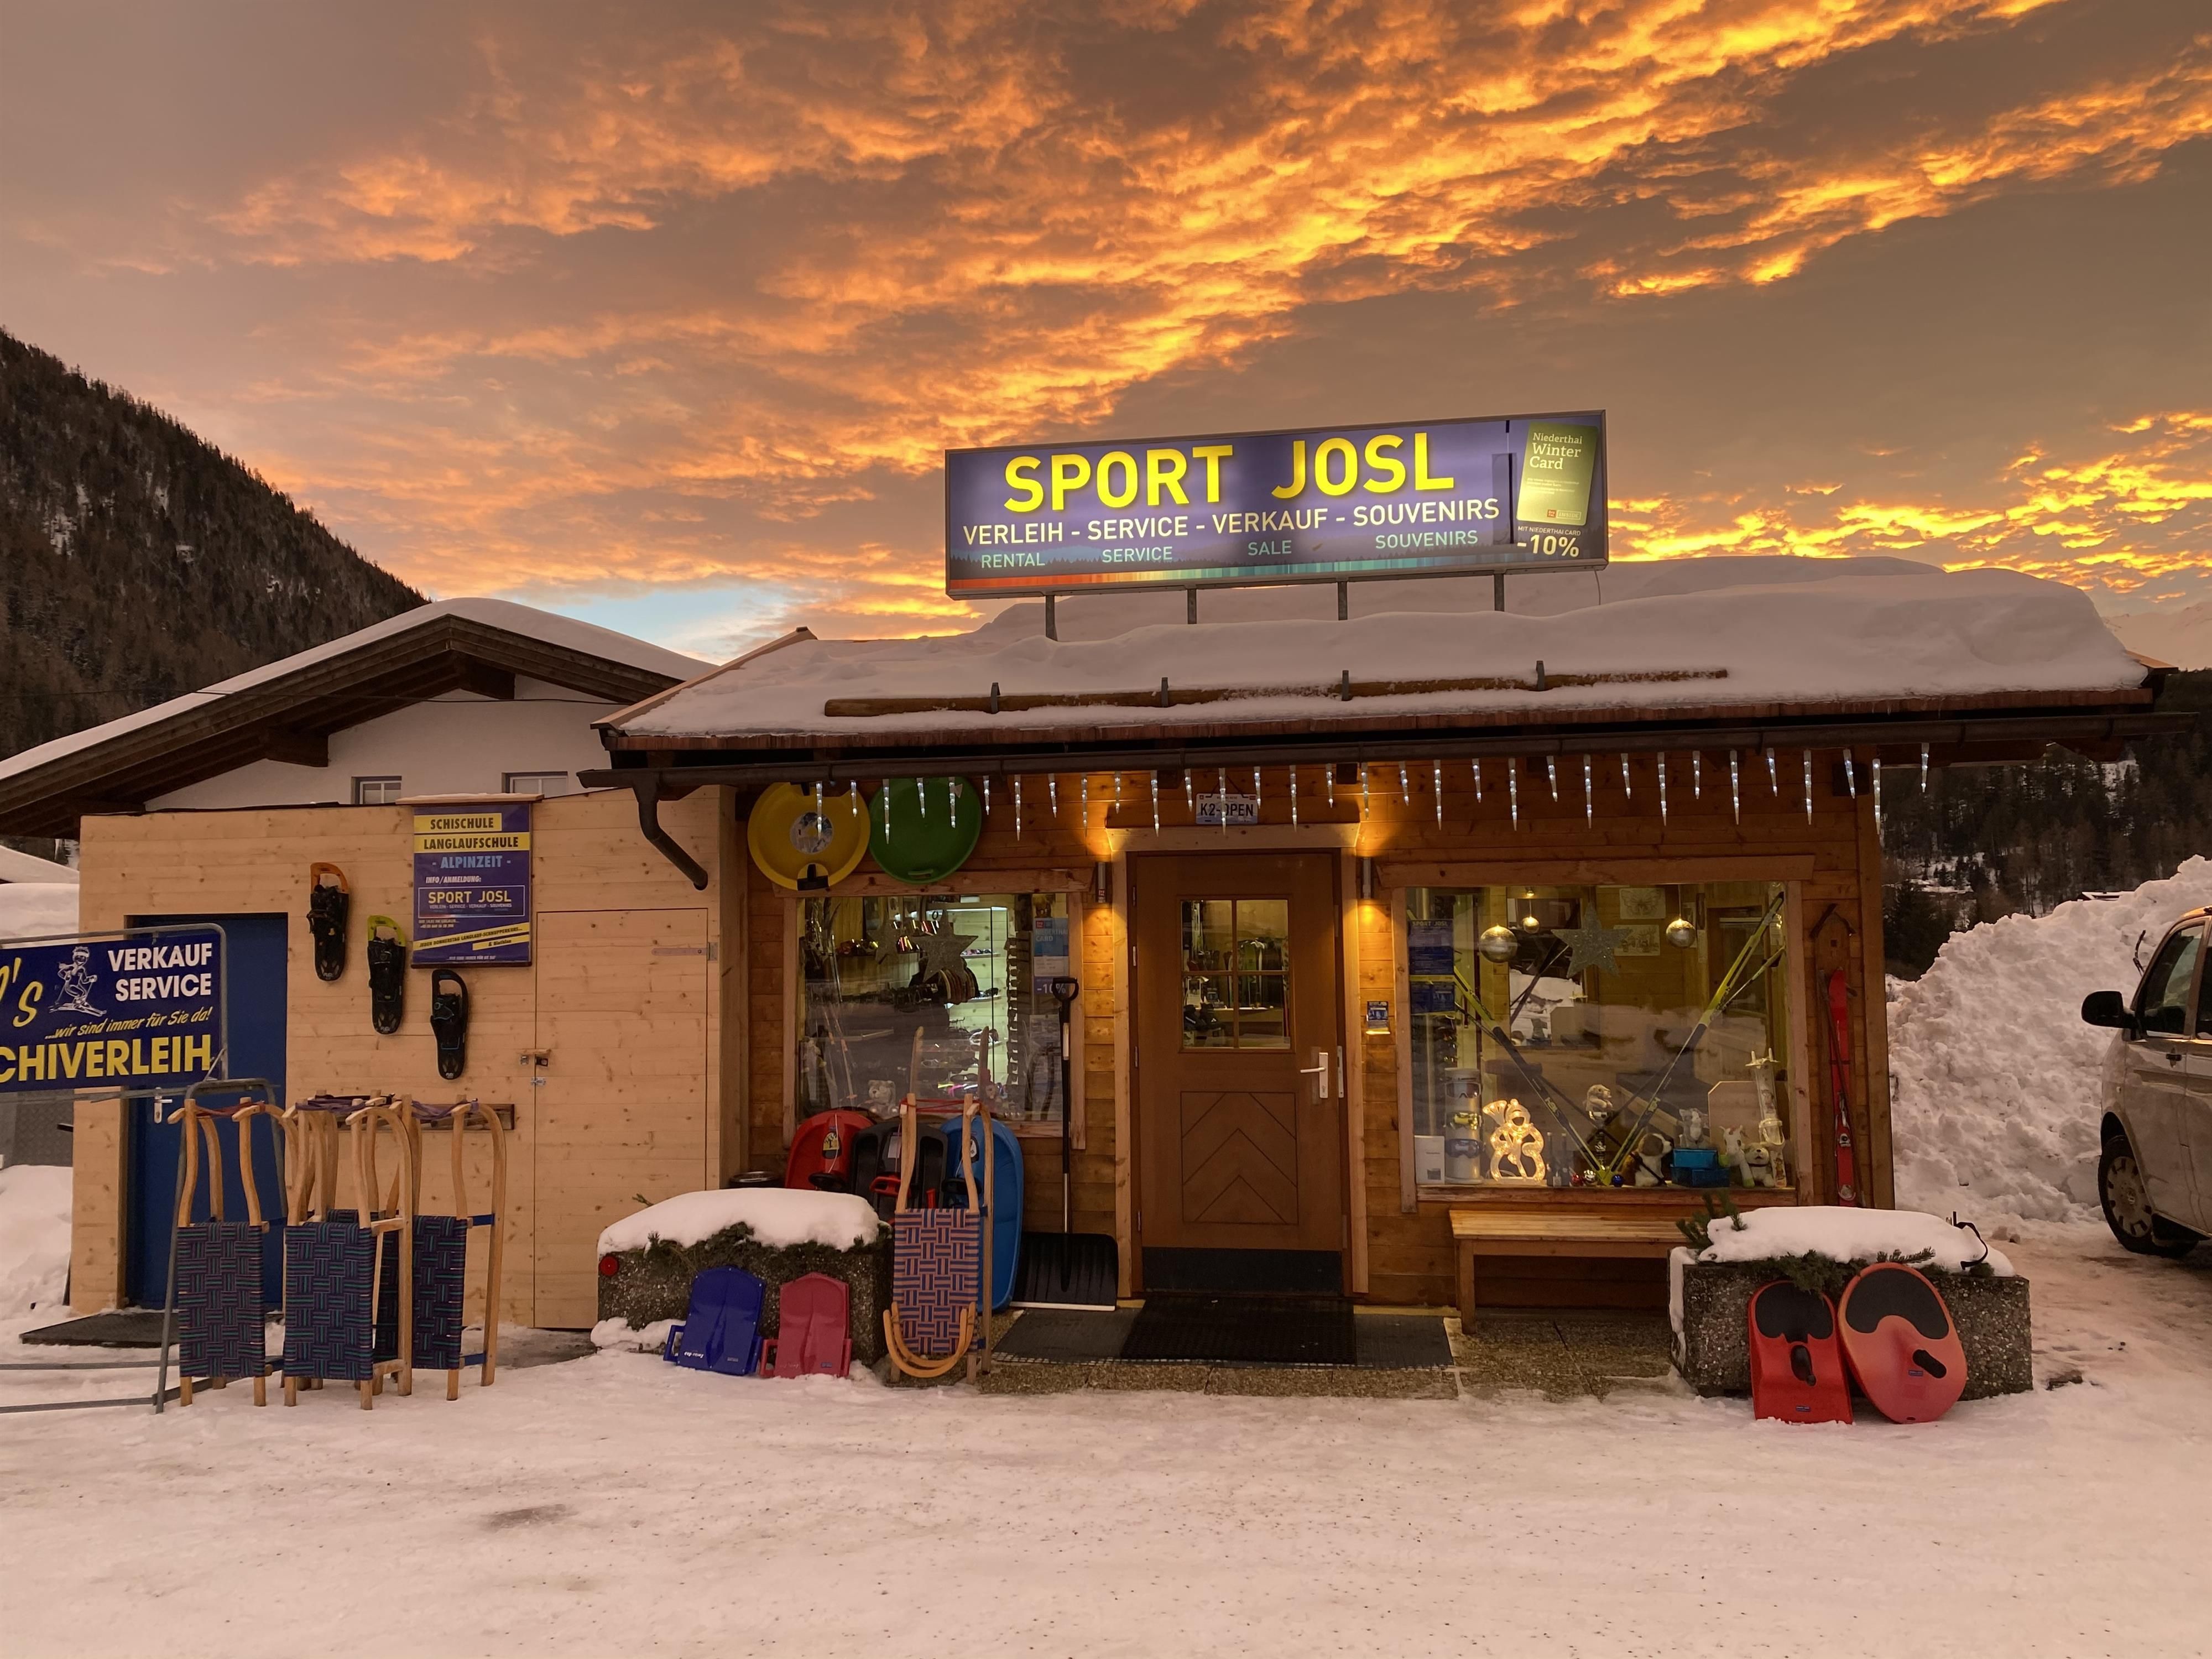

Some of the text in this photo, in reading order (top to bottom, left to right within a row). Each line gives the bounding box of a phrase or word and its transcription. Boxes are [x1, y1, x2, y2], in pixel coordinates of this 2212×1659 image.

[1533, 432, 1582, 444] Niederthai
[1532, 442, 1581, 457] Winter
[1530, 456, 1563, 469] Card
[1004, 432, 1454, 513] SPORT JOSL
[963, 522, 1063, 545] VERLEIH
[1087, 516, 1188, 540] SERVICE
[1213, 508, 1328, 534] VERKAUF
[1353, 498, 1500, 526] SOUVENIRS
[981, 530, 1478, 568] RENTAL SERVICE SALE SOUVENIRS
[1517, 534, 1579, 557] -10%
[430, 817, 494, 830] SCHISCHULE
[424, 837, 519, 849] LANGLAUFSCHULE
[440, 855, 503, 868] ALPINZEIT
[426, 875, 481, 884] INFO/ANMELDUNG:
[428, 890, 512, 904] SPORT JOSL
[108, 943, 212, 972] VERKAUF
[116, 973, 211, 1001] SERVICE
[77, 1018, 108, 1036] sind
[106, 1018, 145, 1033] immer
[145, 1013, 168, 1028] für
[168, 1009, 189, 1025] Sie
[191, 1006, 213, 1022] da!
